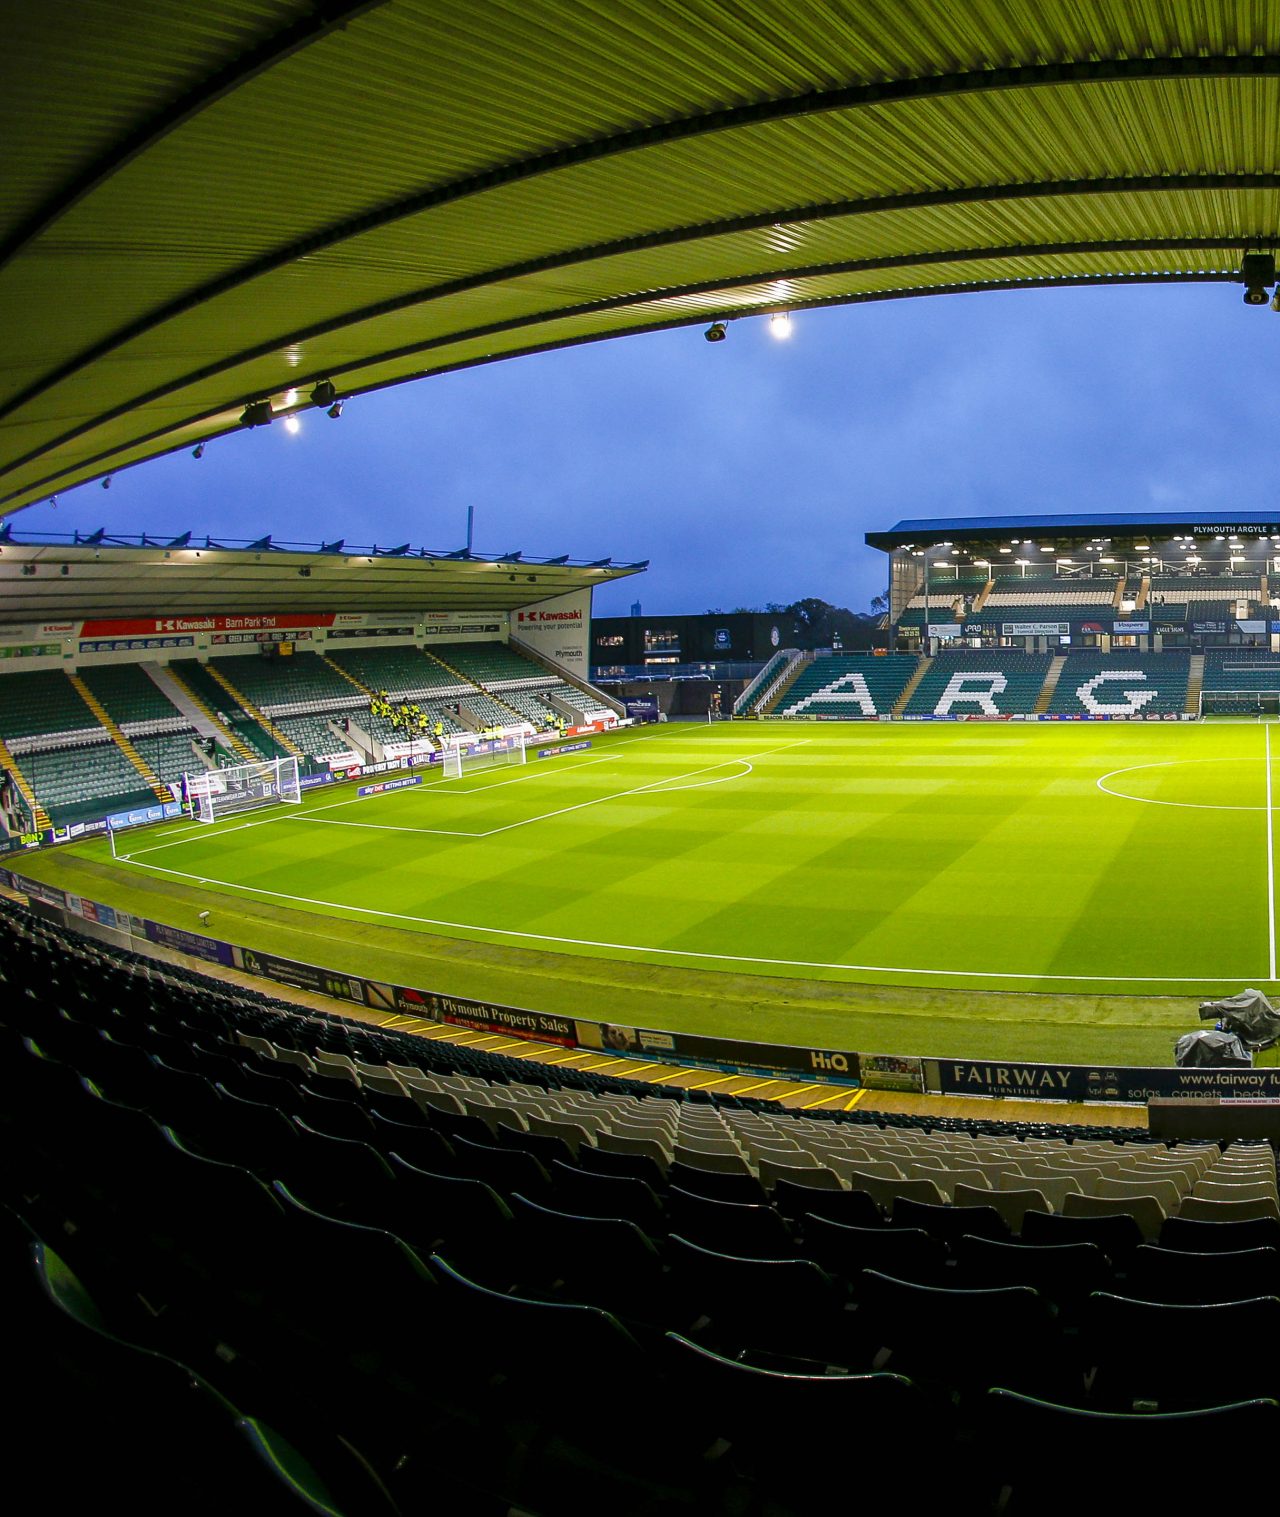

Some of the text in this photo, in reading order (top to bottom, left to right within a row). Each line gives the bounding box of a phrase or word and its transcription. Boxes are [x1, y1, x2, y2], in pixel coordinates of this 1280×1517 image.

[1193, 525, 1236, 534] PLYMOUTH
[1237, 526, 1267, 534] ARGYLE
[539, 608, 582, 621] Kawasaki
[176, 616, 276, 630] Kawasaki Barn Park End
[517, 622, 582, 632] Powering your potential
[555, 650, 582, 658] Plymouth
[364, 786, 374, 794] sky
[374, 784, 384, 792] bet
[400, 999, 428, 1014] Plymouth
[442, 998, 569, 1034] Plymouth Property Sales
[810, 1051, 849, 1072] HiQ
[954, 1065, 1071, 1088] FAIRWAY
[1180, 1074, 1266, 1086] www.fairway
[988, 1086, 1040, 1096] FURNITURE
[1128, 1087, 1161, 1098] sofas
[1171, 1088, 1222, 1098] carpets
[1233, 1088, 1266, 1098] beds
